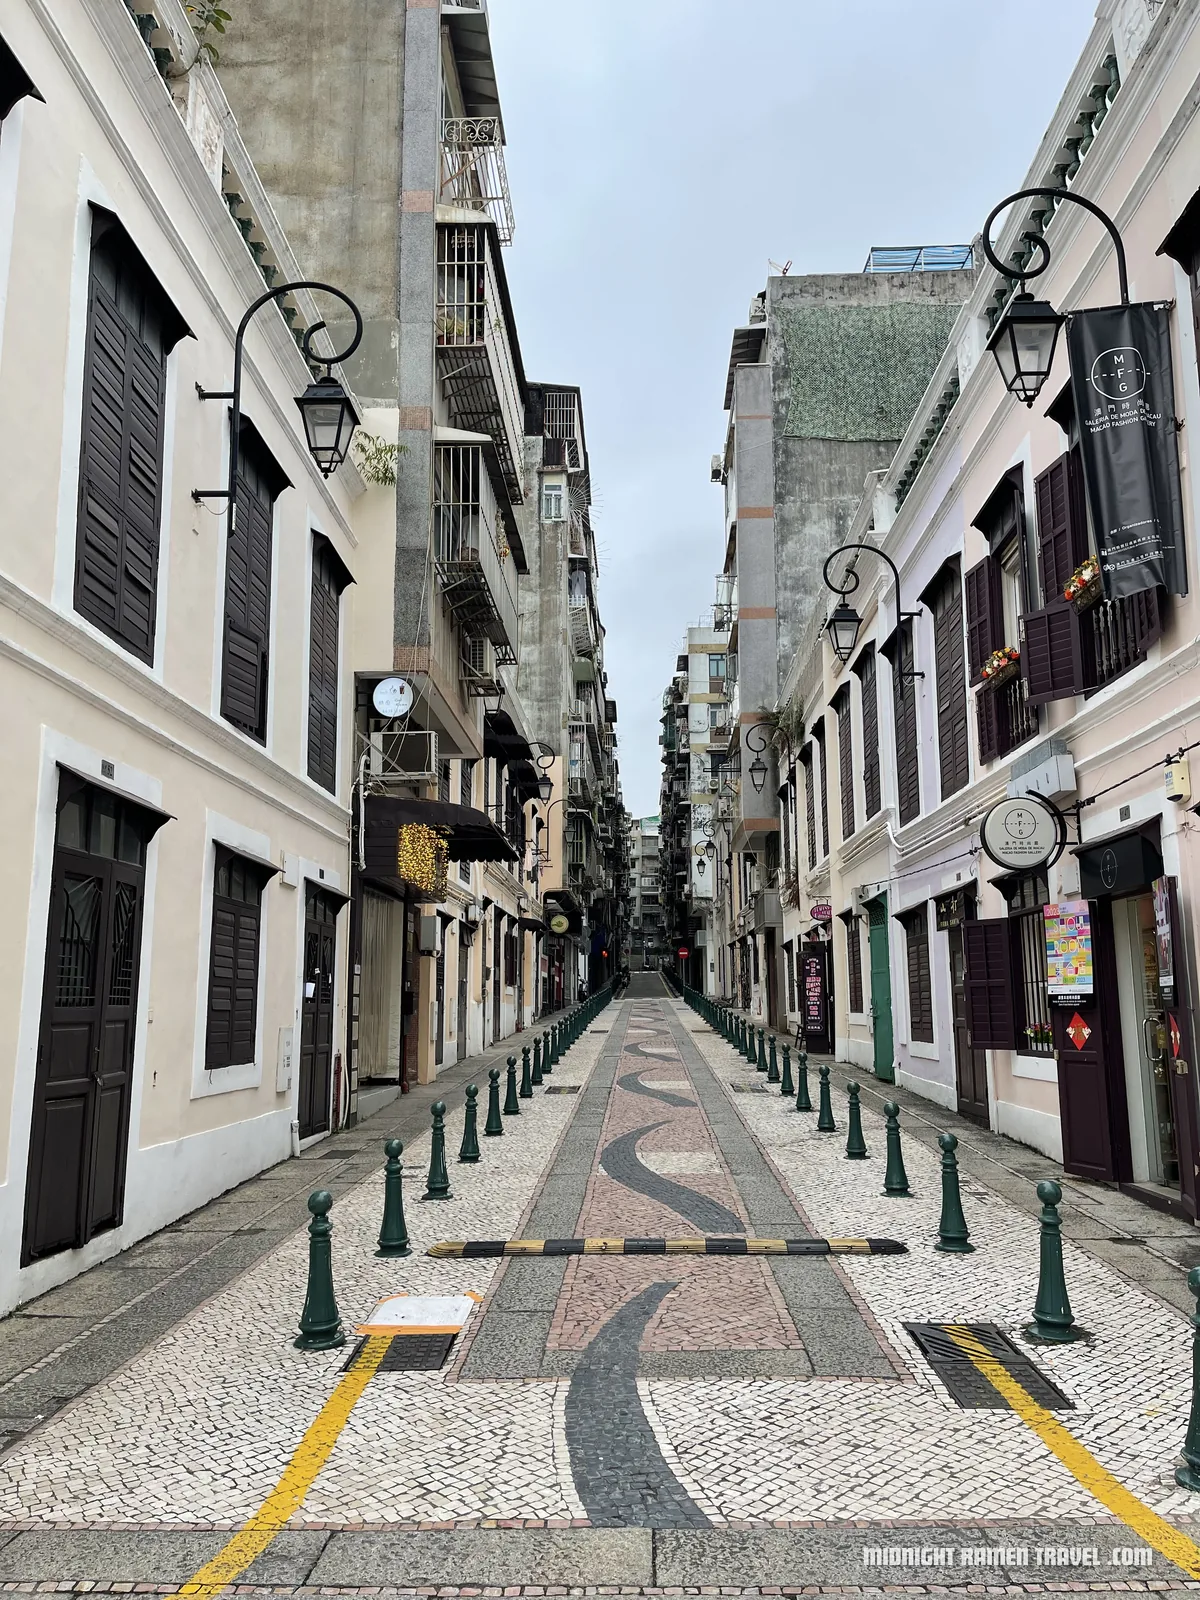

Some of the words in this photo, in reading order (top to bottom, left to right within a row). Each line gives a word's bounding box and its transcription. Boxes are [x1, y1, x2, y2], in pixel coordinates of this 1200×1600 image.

[1085, 415, 1109, 426] GALERIA
[1120, 409, 1138, 418] MODA
[1090, 422, 1110, 433] MACAO
[1112, 416, 1138, 427] FASHION
